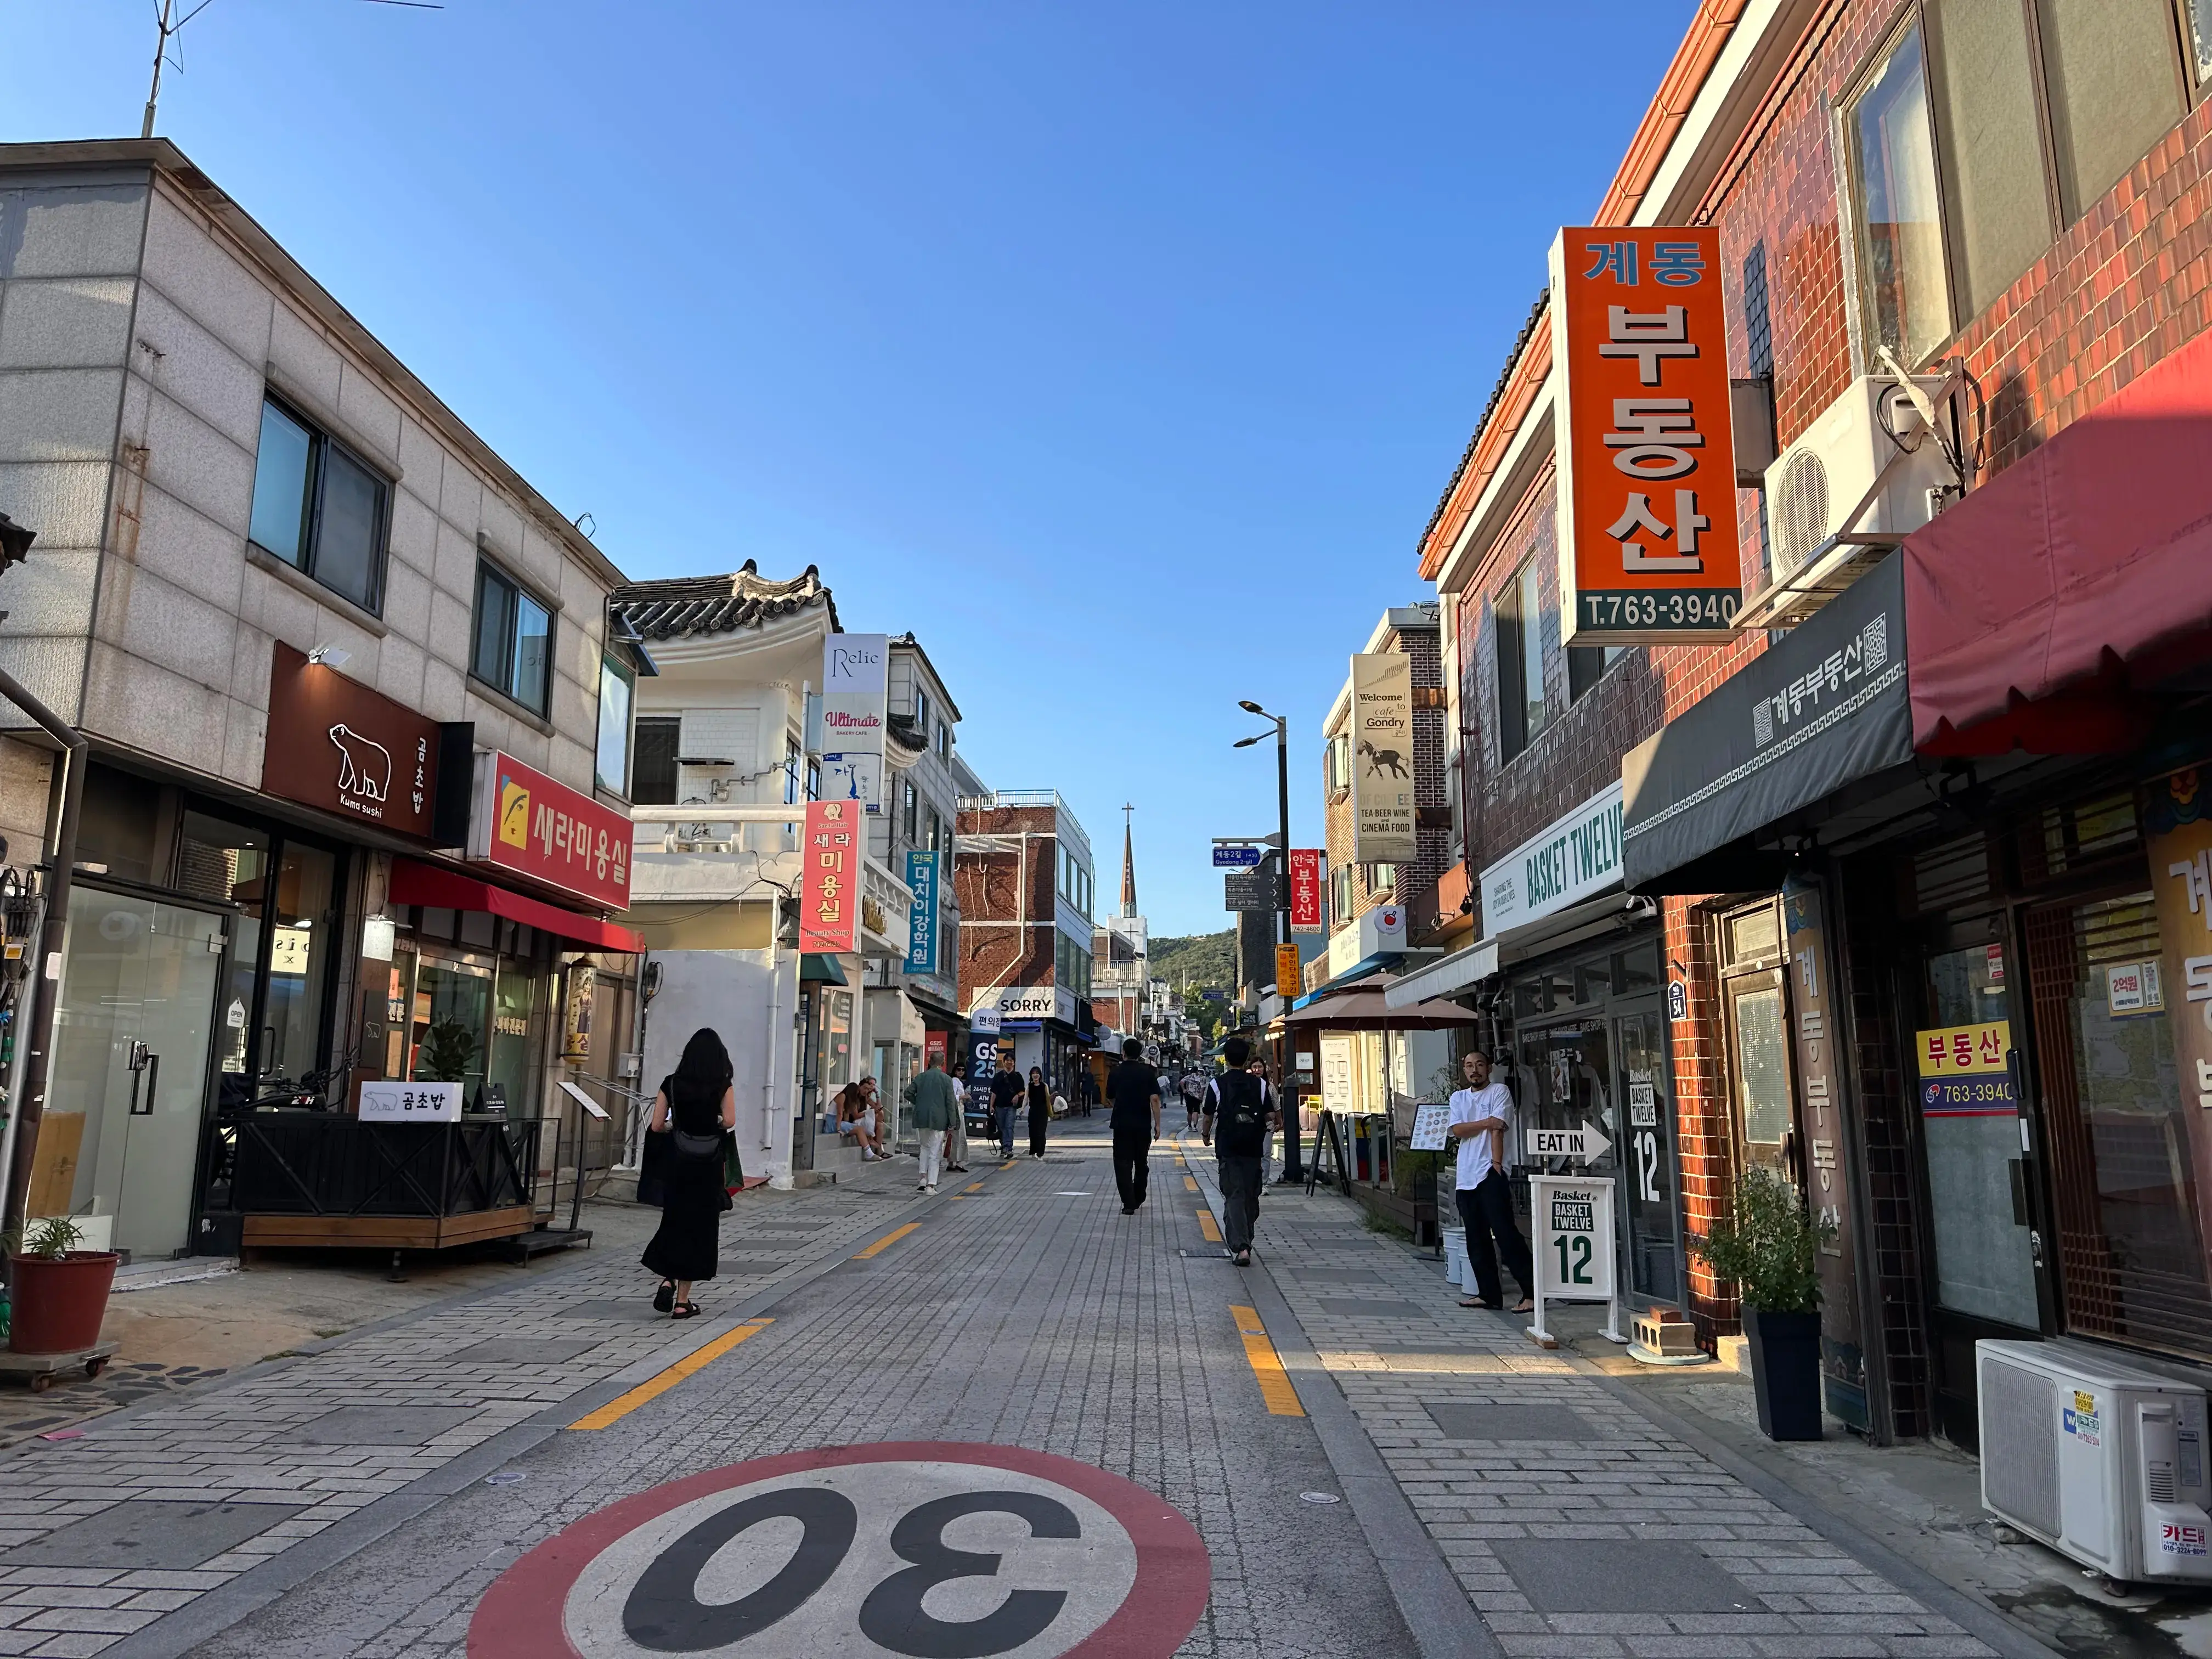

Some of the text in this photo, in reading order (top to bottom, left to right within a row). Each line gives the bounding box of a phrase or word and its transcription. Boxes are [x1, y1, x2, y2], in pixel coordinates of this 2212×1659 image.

[1583, 240, 1706, 286] 계동
[1598, 304, 1711, 574] 부동산
[1585, 594, 1736, 625] T.763-3940
[832, 648, 878, 678] Relic
[1772, 635, 1863, 724] 계동부동산
[1359, 693, 1402, 701] Welcome
[825, 711, 882, 727] Ultimate
[1374, 707, 1394, 718] cafe
[1367, 718, 1405, 729] Gondry
[413, 737, 427, 814] 곰초밥
[340, 793, 382, 819] Kuma sushi
[1362, 823, 1410, 832] CINEMA FOOD
[534, 802, 627, 885] 새라미용실
[912, 854, 933, 865] 안국
[1215, 850, 1242, 859] 계동2길
[1292, 854, 1317, 867] 안국
[1526, 835, 1567, 909] BASKET
[816, 850, 843, 923] 미용실
[1296, 869, 1314, 921] 부동산
[806, 929, 850, 939] Beauty Shop
[2113, 975, 2138, 993] 2억원
[231, 1010, 243, 1018] OPEN
[1001, 999, 1051, 1012] SORRY
[1673, 999, 1681, 1015] 54
[1590, 1019, 1601, 1031] SHOP
[975, 1042, 998, 1060] GS
[1928, 1028, 2001, 1069] 부동산
[974, 1060, 996, 1079] 25
[1629, 1068, 1652, 1082] Basket
[403, 1091, 445, 1111] 곰초밥
[1632, 1087, 1652, 1104] BASKET
[1795, 945, 1842, 1258] 계동부동산
[1632, 1105, 1654, 1122] TWELVE
[1537, 1133, 1584, 1152] EAT IN
[1633, 1131, 1660, 1202] 12
[1552, 1190, 1591, 1201] Basket
[1555, 1203, 1589, 1217] BASKET
[1554, 1216, 1591, 1229] TWELVE
[1554, 1234, 1593, 1284] 12
[2163, 1524, 2198, 1543] 카드
[622, 1486, 1081, 1658] 30
